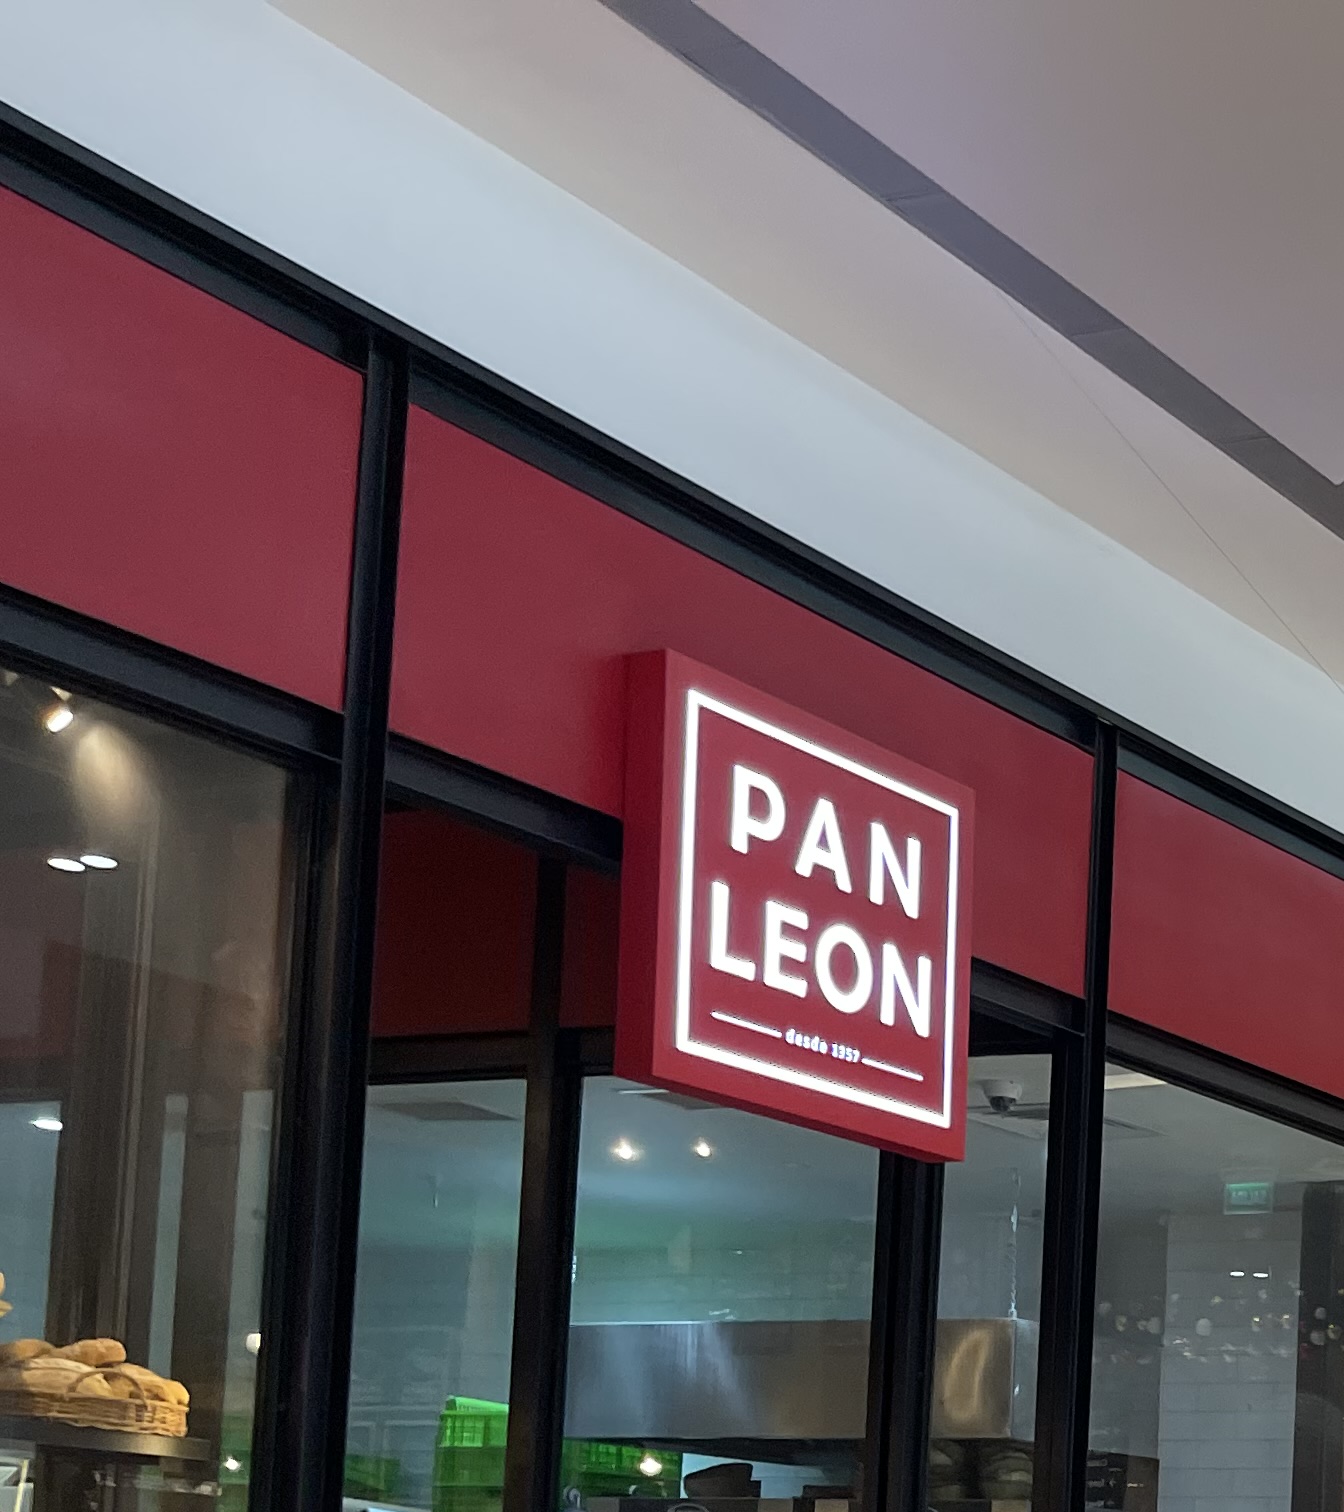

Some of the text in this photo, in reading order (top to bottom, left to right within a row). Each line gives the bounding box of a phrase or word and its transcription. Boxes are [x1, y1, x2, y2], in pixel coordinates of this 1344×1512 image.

[729, 762, 922, 920] PAN
[708, 880, 932, 1039] LEON
[785, 1028, 828, 1055] desde
